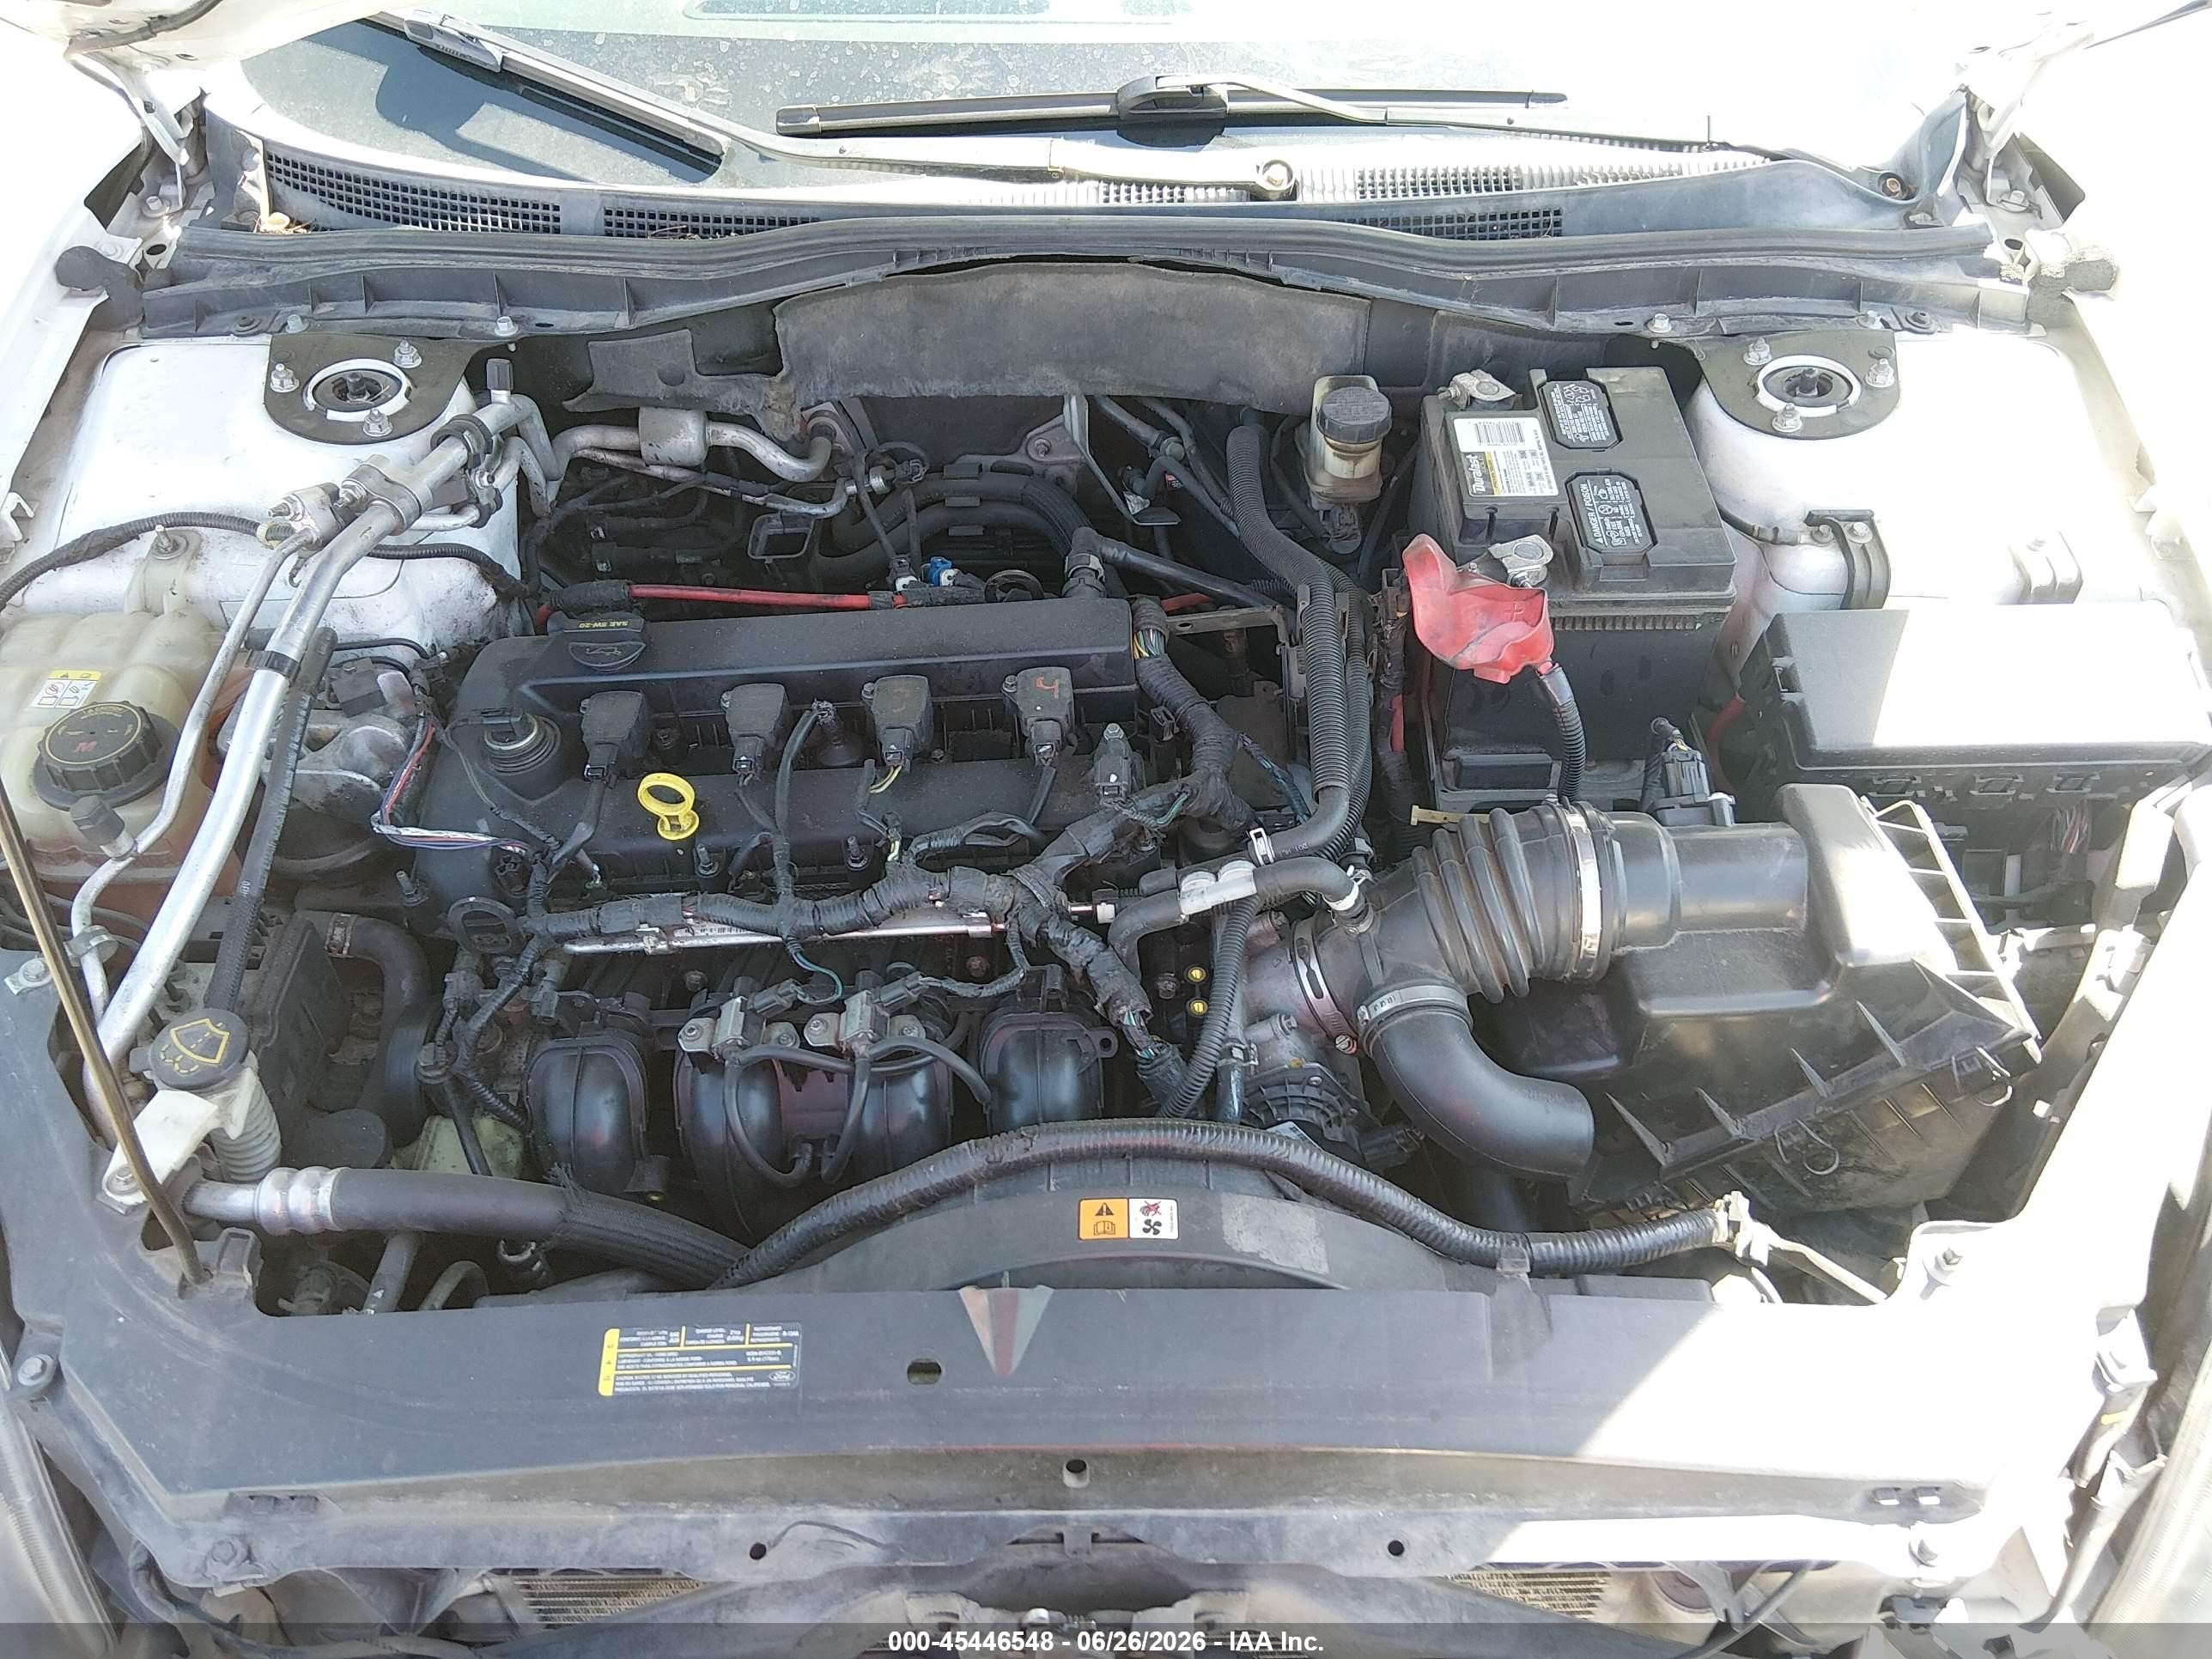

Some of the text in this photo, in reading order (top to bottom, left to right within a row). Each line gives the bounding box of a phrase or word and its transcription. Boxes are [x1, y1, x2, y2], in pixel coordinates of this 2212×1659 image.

[1466, 454, 1486, 493] Duralast
[1580, 483, 1593, 507] POISON
[1588, 512, 1602, 538] DANGER
